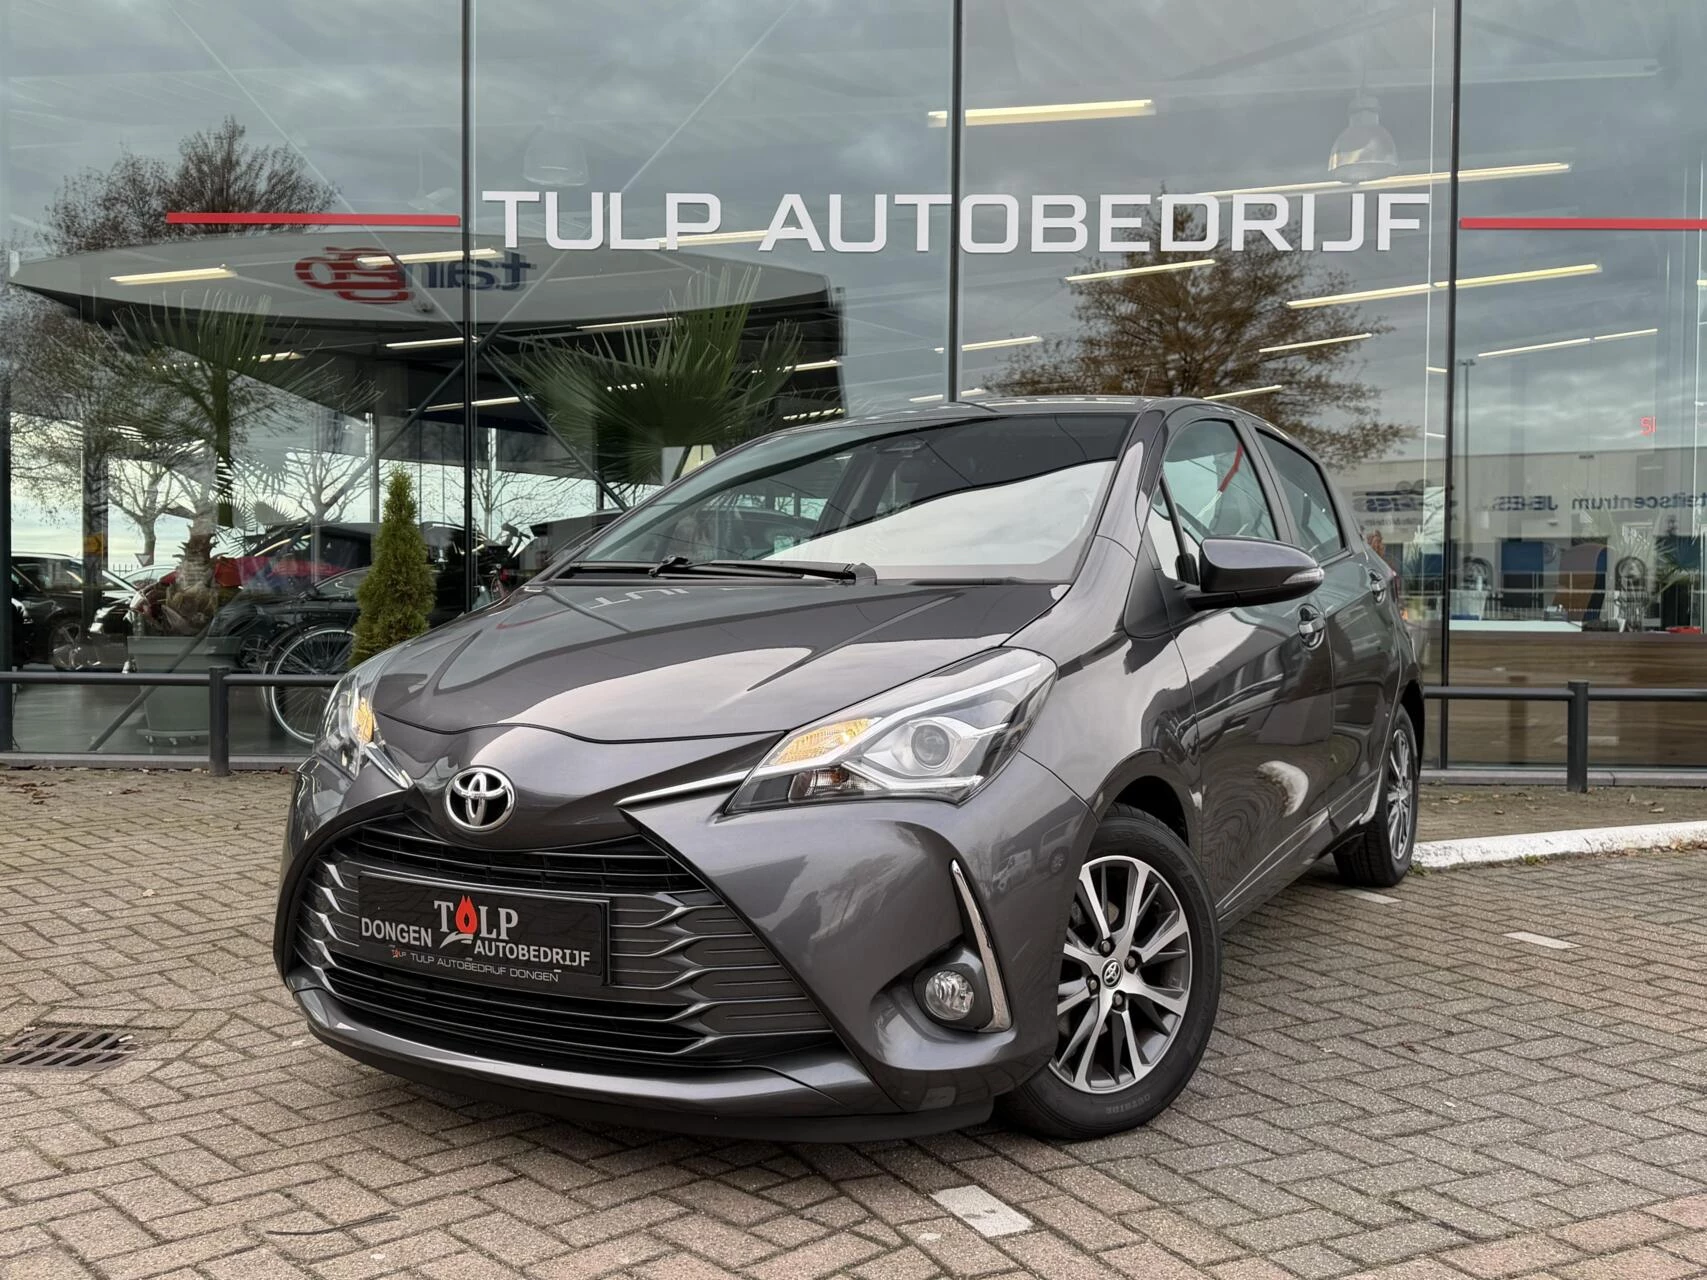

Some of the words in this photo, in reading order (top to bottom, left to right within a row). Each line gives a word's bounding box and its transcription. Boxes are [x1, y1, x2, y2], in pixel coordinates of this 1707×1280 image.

[482, 191, 721, 251] TULP
[758, 192, 1430, 253] AUTOBEDRIJF
[361, 917, 432, 947] DONGEN
[410, 952, 435, 964] TULP
[437, 957, 507, 975] AUTOBEDRIJF
[510, 968, 559, 983] DONGEN
[474, 939, 591, 967] AUTOBEDRIJF
